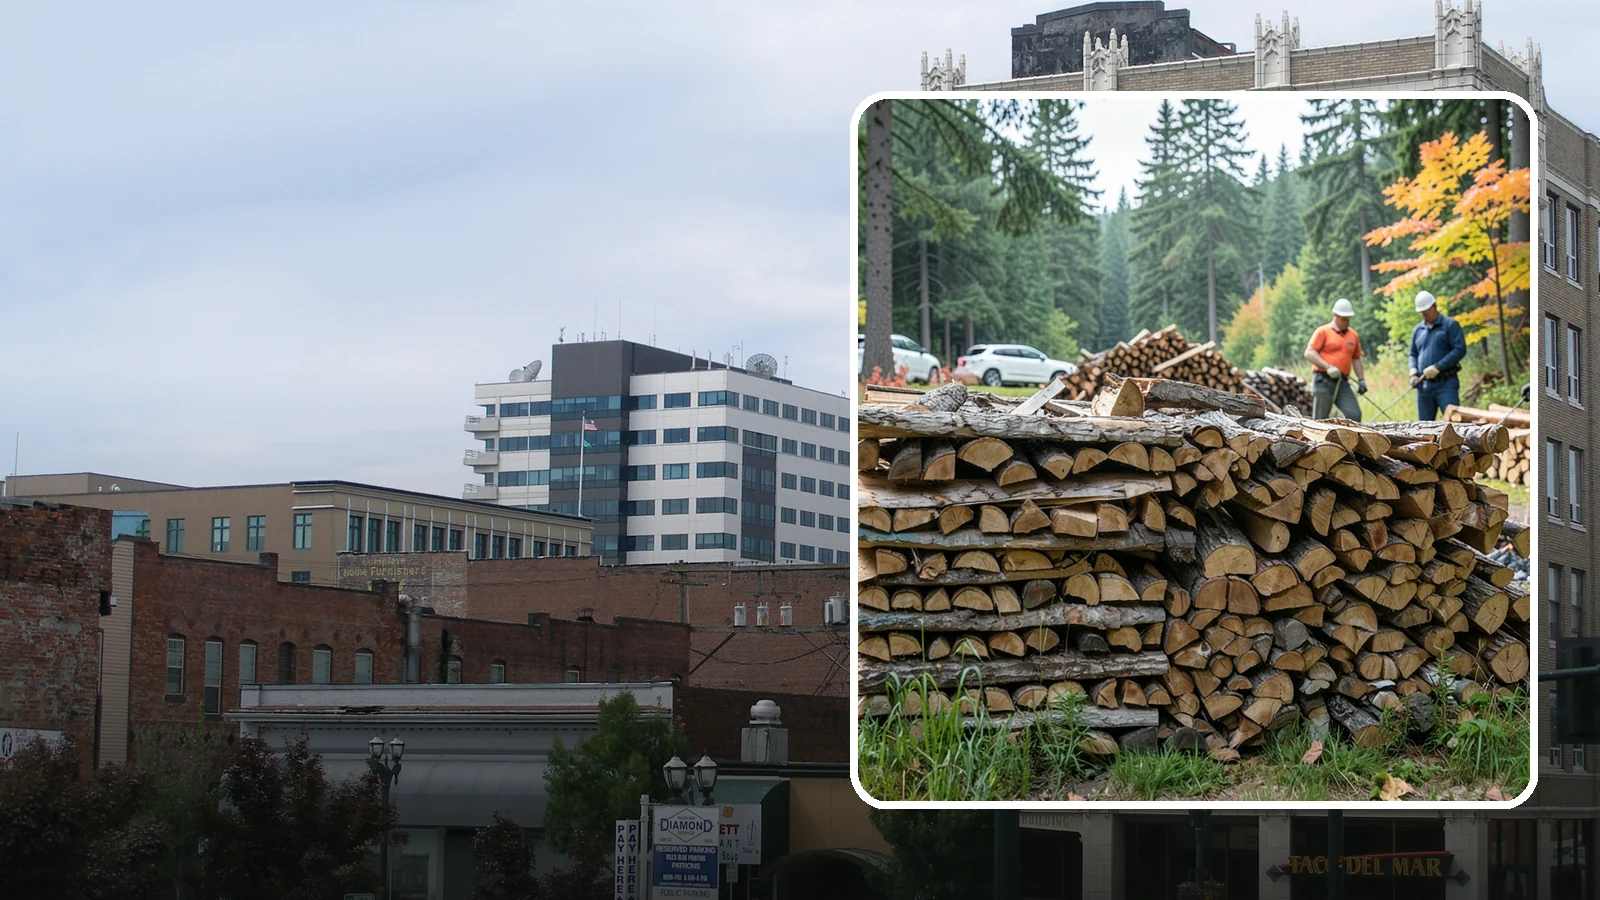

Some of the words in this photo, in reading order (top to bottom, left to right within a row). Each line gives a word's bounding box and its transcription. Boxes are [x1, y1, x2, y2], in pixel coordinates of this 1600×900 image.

[660, 818, 713, 832] DIAMOND
[1022, 815, 1069, 827] BUILDING
[617, 824, 625, 852] PAY
[628, 824, 636, 852] PAY
[656, 845, 688, 853] RESERVED
[689, 846, 716, 854] PARKING
[722, 852, 739, 863] Soup
[616, 856, 625, 893] HERE
[628, 855, 636, 893] HERE
[1346, 856, 1385, 875] DEL
[1392, 857, 1442, 877] MAR
[660, 889, 681, 897] PUBLIC
[683, 890, 710, 898] PARKING
